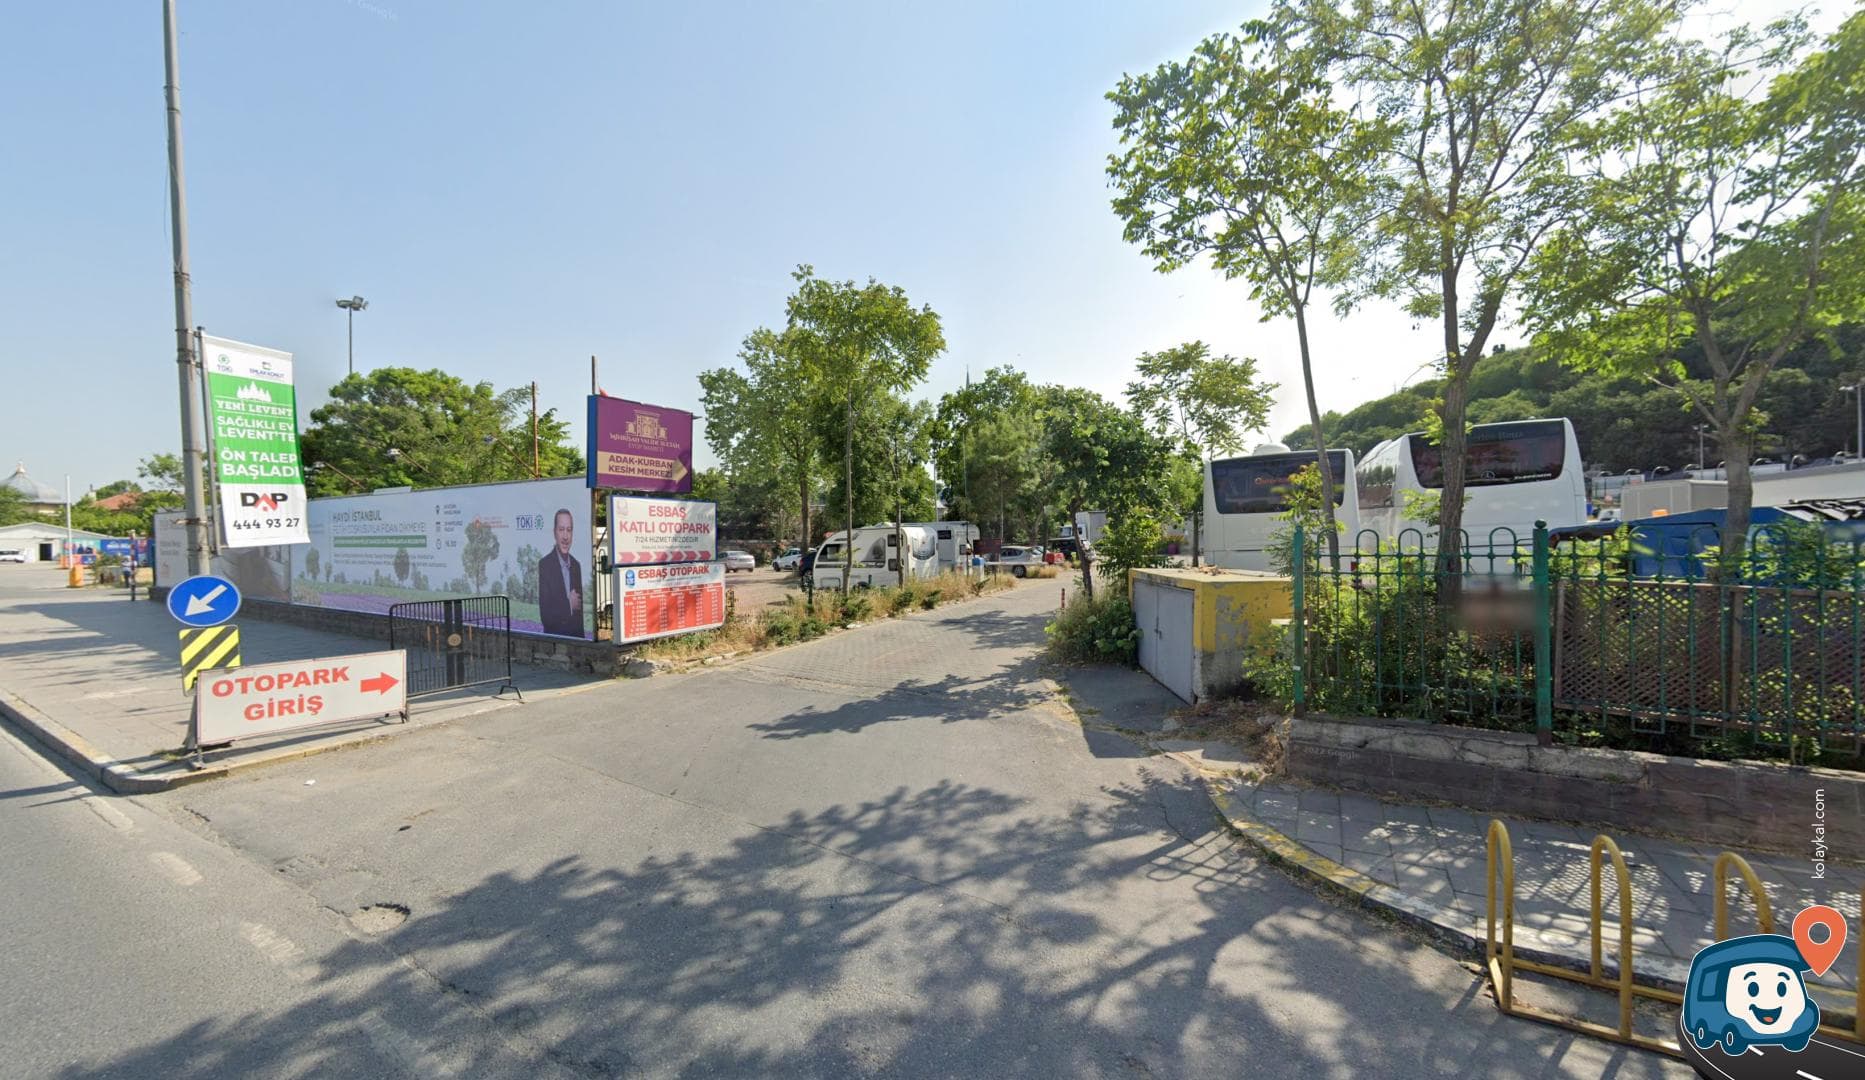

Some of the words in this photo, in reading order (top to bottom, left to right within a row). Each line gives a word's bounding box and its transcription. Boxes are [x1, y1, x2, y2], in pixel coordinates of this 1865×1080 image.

[216, 400, 246, 411] YENİ
[249, 404, 293, 417] LEVENT
[217, 416, 275, 430] SAĞLIKLI
[279, 421, 294, 431] EV
[218, 427, 296, 442] LEVENT'TE
[220, 447, 246, 461] ÖN
[249, 451, 298, 463] TALEP
[609, 455, 673, 469] ADAK-KURBAN
[222, 463, 300, 480] BAŞLADI
[608, 465, 635, 475] KESİM
[637, 468, 673, 478] MERKEZİ
[240, 492, 289, 512] DAP
[648, 505, 687, 520] ESBAŞ
[233, 520, 261, 530] 444
[266, 519, 281, 528] 93
[286, 518, 300, 528] 27
[619, 521, 654, 533] KATLI
[658, 522, 710, 534] OTOPARK
[638, 567, 668, 580] ESBAŞ
[670, 565, 710, 576] OTOPARK
[211, 666, 350, 697] OTOPARK
[244, 694, 324, 721] GİRİŞ
